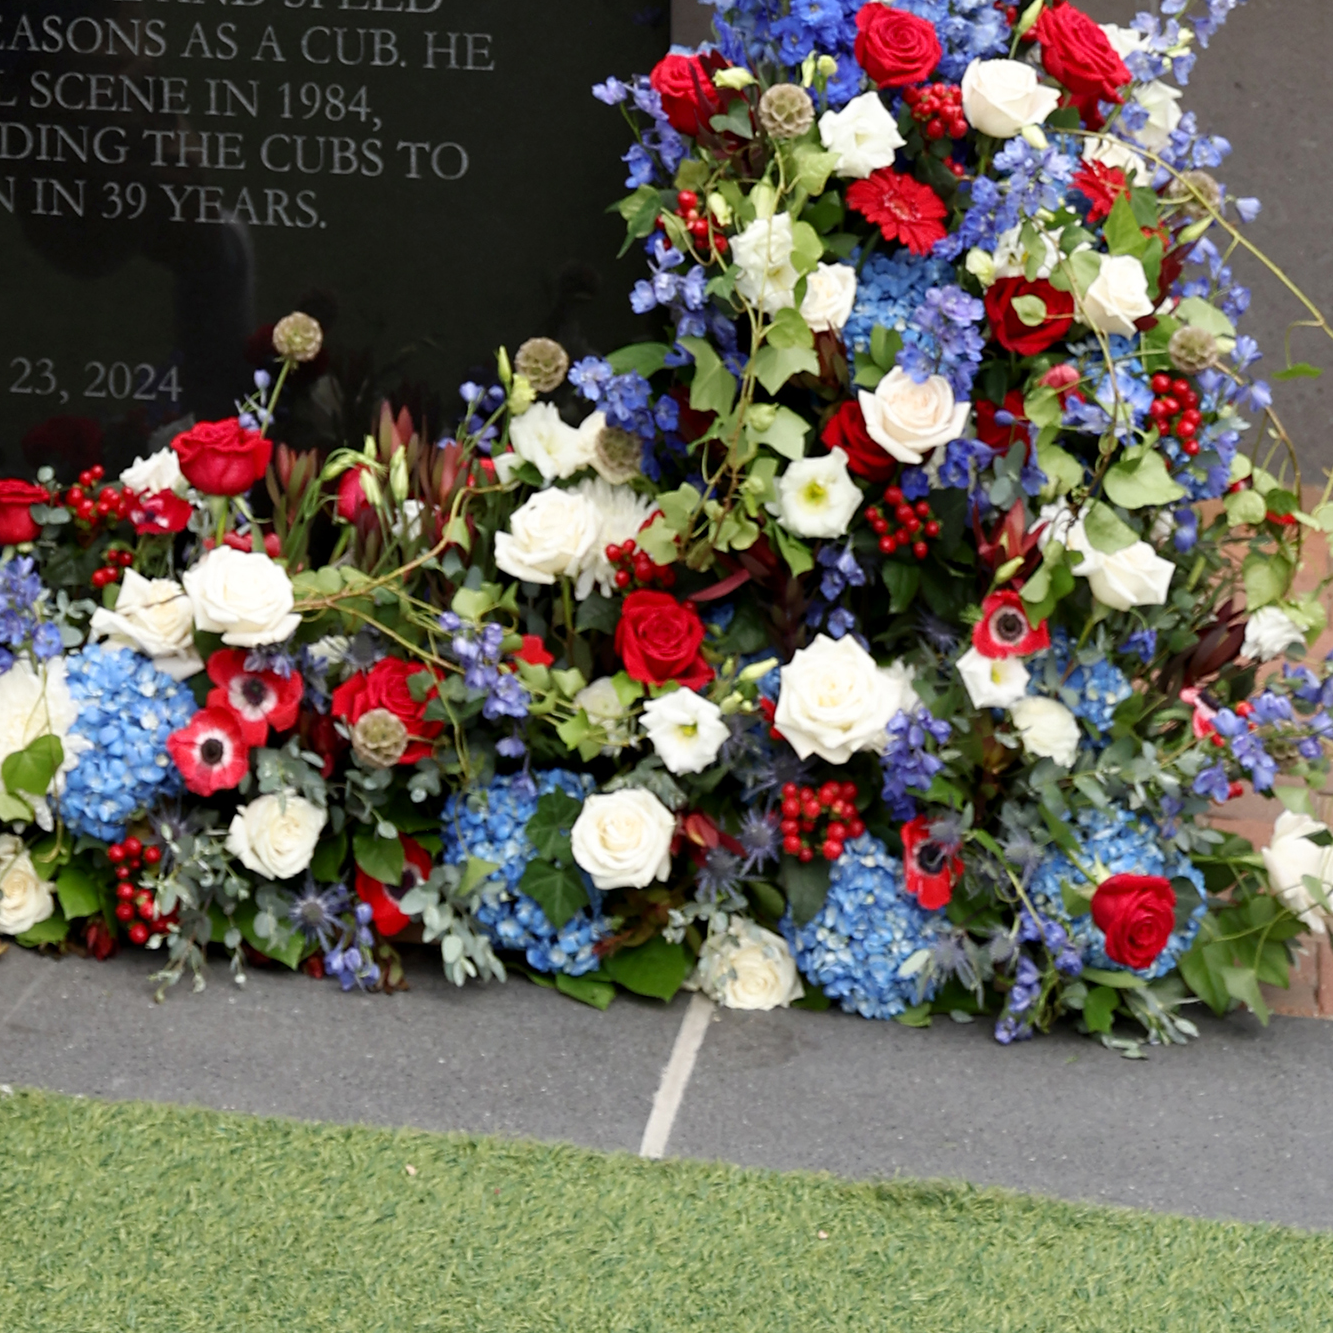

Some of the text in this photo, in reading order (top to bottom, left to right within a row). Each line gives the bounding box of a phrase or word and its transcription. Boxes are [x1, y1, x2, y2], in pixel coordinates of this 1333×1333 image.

[180, 21, 239, 61] AS
[252, 24, 287, 63] A
[300, 25, 408, 68] CUB.
[422, 30, 496, 72] HE
[29, 70, 191, 115] SCENE
[204, 78, 261, 119] IN
[277, 81, 384, 133] 1984,
[142, 129, 248, 171] THE
[260, 133, 385, 178] CUBS
[397, 139, 471, 181] TO
[31, 177, 87, 218] IN
[100, 181, 148, 221] 39
[160, 184, 328, 230] YEARS.
[9, 356, 71, 405] 23,
[83, 360, 184, 402] 2024
